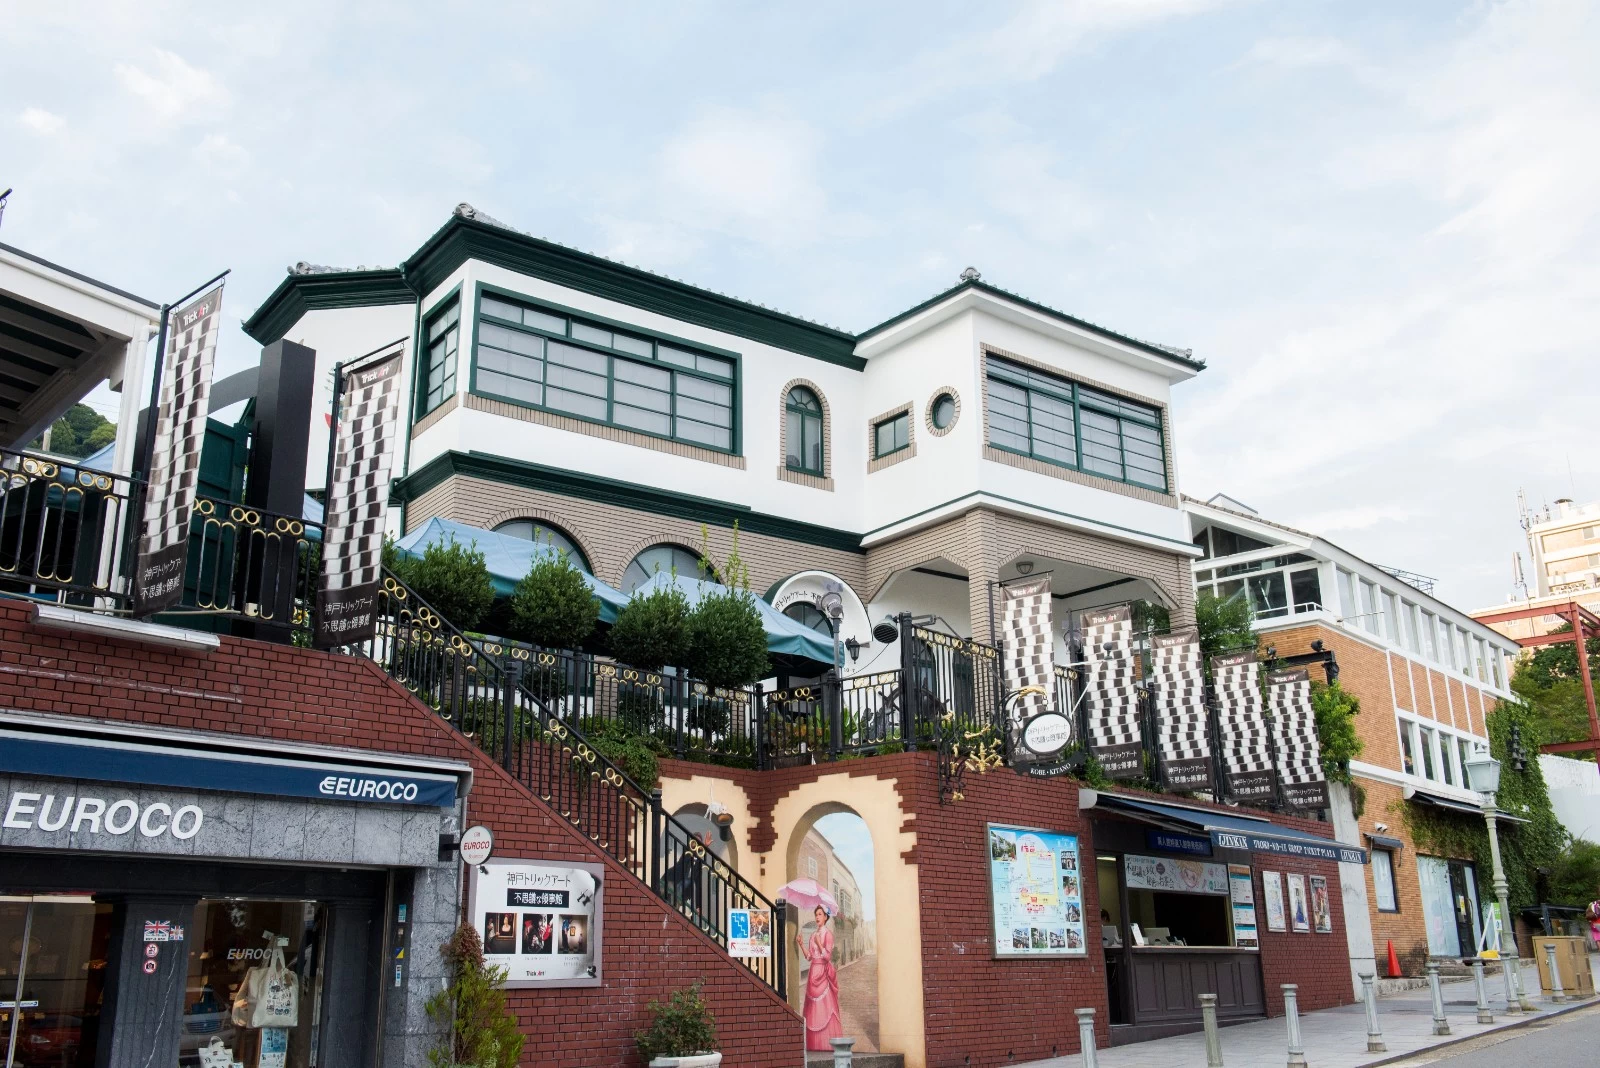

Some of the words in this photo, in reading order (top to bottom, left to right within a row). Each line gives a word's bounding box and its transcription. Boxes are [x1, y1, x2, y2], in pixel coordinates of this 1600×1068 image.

[183, 310, 198, 326] Trick
[198, 303, 209, 319] Art
[361, 371, 377, 384] Trick
[377, 366, 389, 378] Art
[1011, 588, 1027, 597] Trick
[1026, 585, 1037, 595] Art
[774, 590, 808, 611] 戸トリックアート
[1091, 615, 1107, 624] Trick
[1106, 613, 1117, 623] Art
[1161, 638, 1175, 646] Trick
[1221, 658, 1235, 666] Trick
[1234, 656, 1244, 665] Art
[1287, 674, 1296, 682] Art
[1098, 749, 1137, 761] 神戸トリックアート
[1030, 767, 1047, 776] KOBE
[1049, 762, 1071, 776] KITANO
[1168, 764, 1207, 775] 神戸トリックアート
[1233, 776, 1270, 787] 神戸トリックアート
[334, 777, 419, 801] EUROCO
[1286, 787, 1322, 797] 神戸トリックアート
[3, 791, 204, 840] EUROCO
[463, 840, 490, 851] EUROCO
[1287, 843, 1303, 854] GROUP
[1303, 846, 1320, 856] TICKET
[1320, 848, 1336, 858] PLAZA
[506, 871, 571, 888] 神戸トリックアート
[513, 891, 564, 905] 不思議な領事館
[227, 948, 274, 960] EUROC
[537, 969, 545, 977] Art
